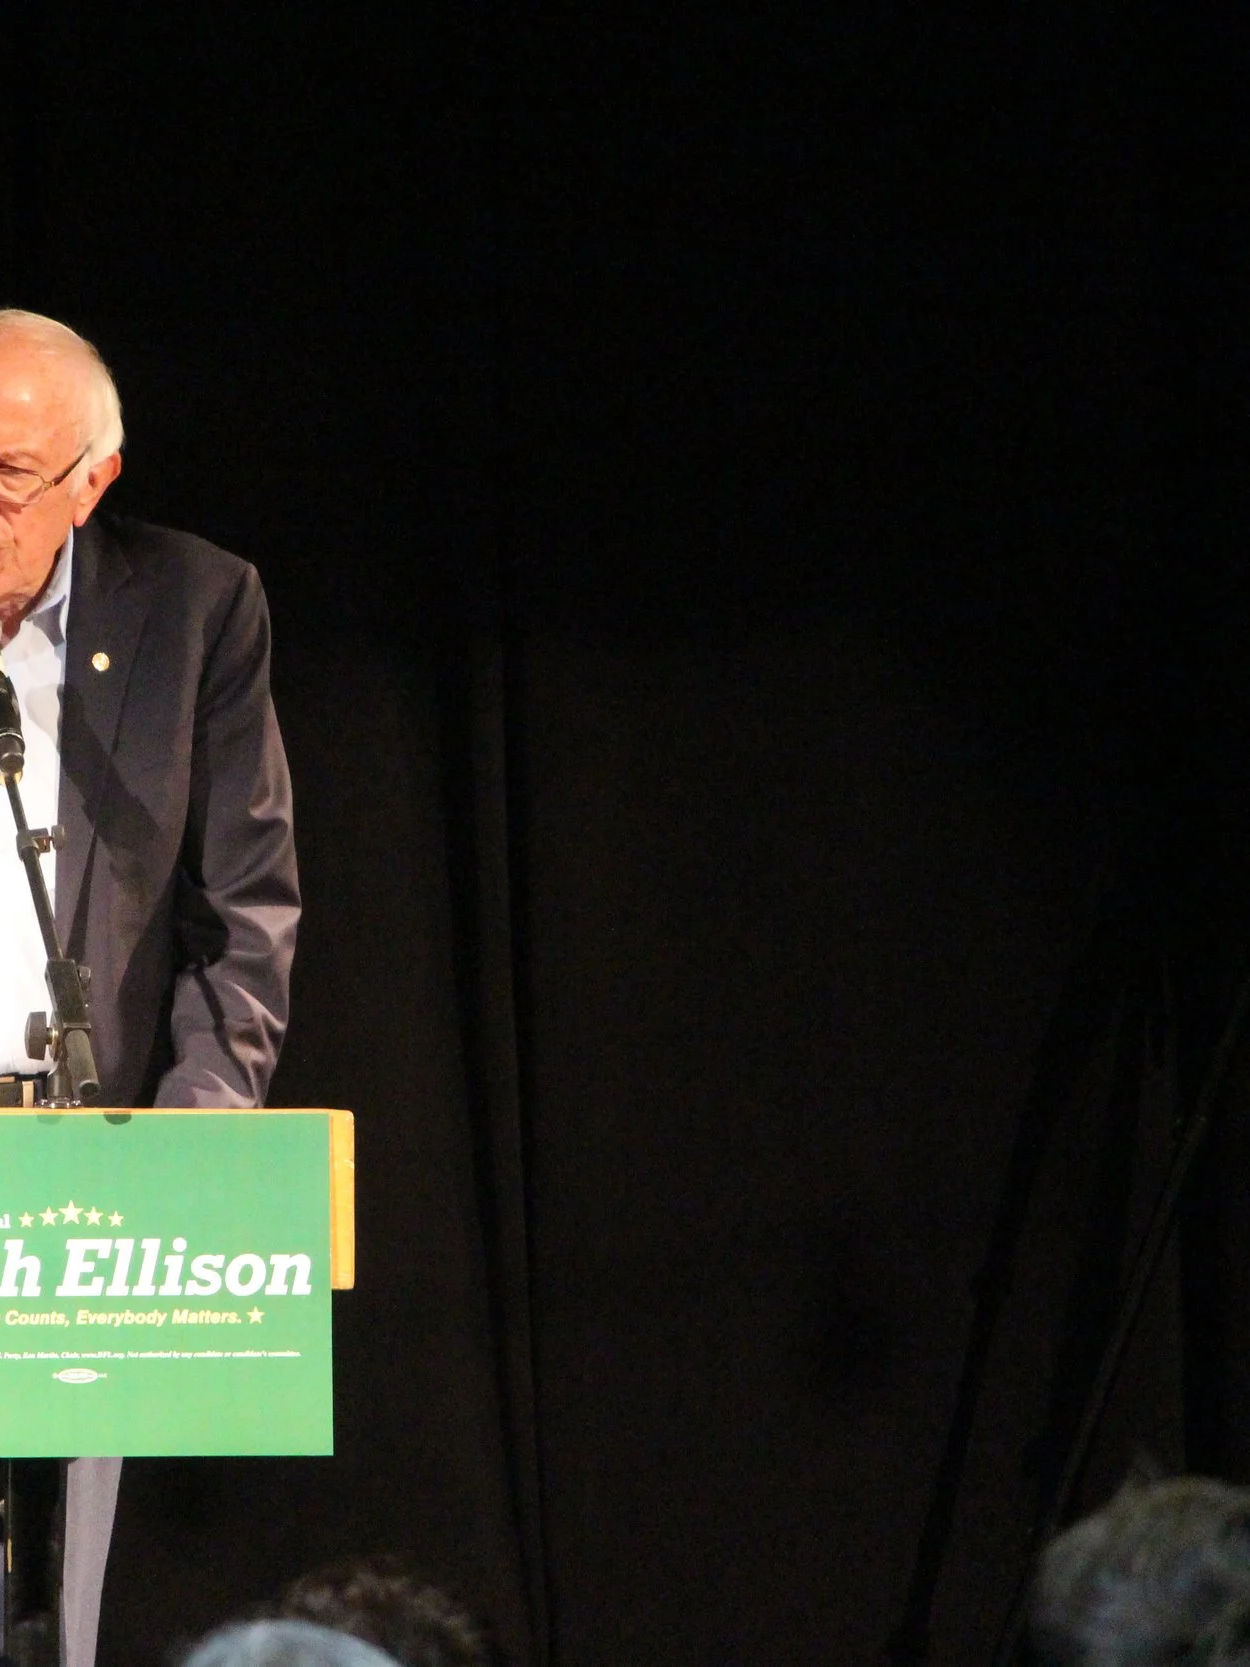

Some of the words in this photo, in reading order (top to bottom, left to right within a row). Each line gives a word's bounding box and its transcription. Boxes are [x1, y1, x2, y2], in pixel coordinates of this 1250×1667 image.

[55, 1237, 312, 1297] Ellison
[4, 1309, 70, 1328] Counts,
[75, 1309, 167, 1328] Everybody
[171, 1308, 242, 1325] Matters.
